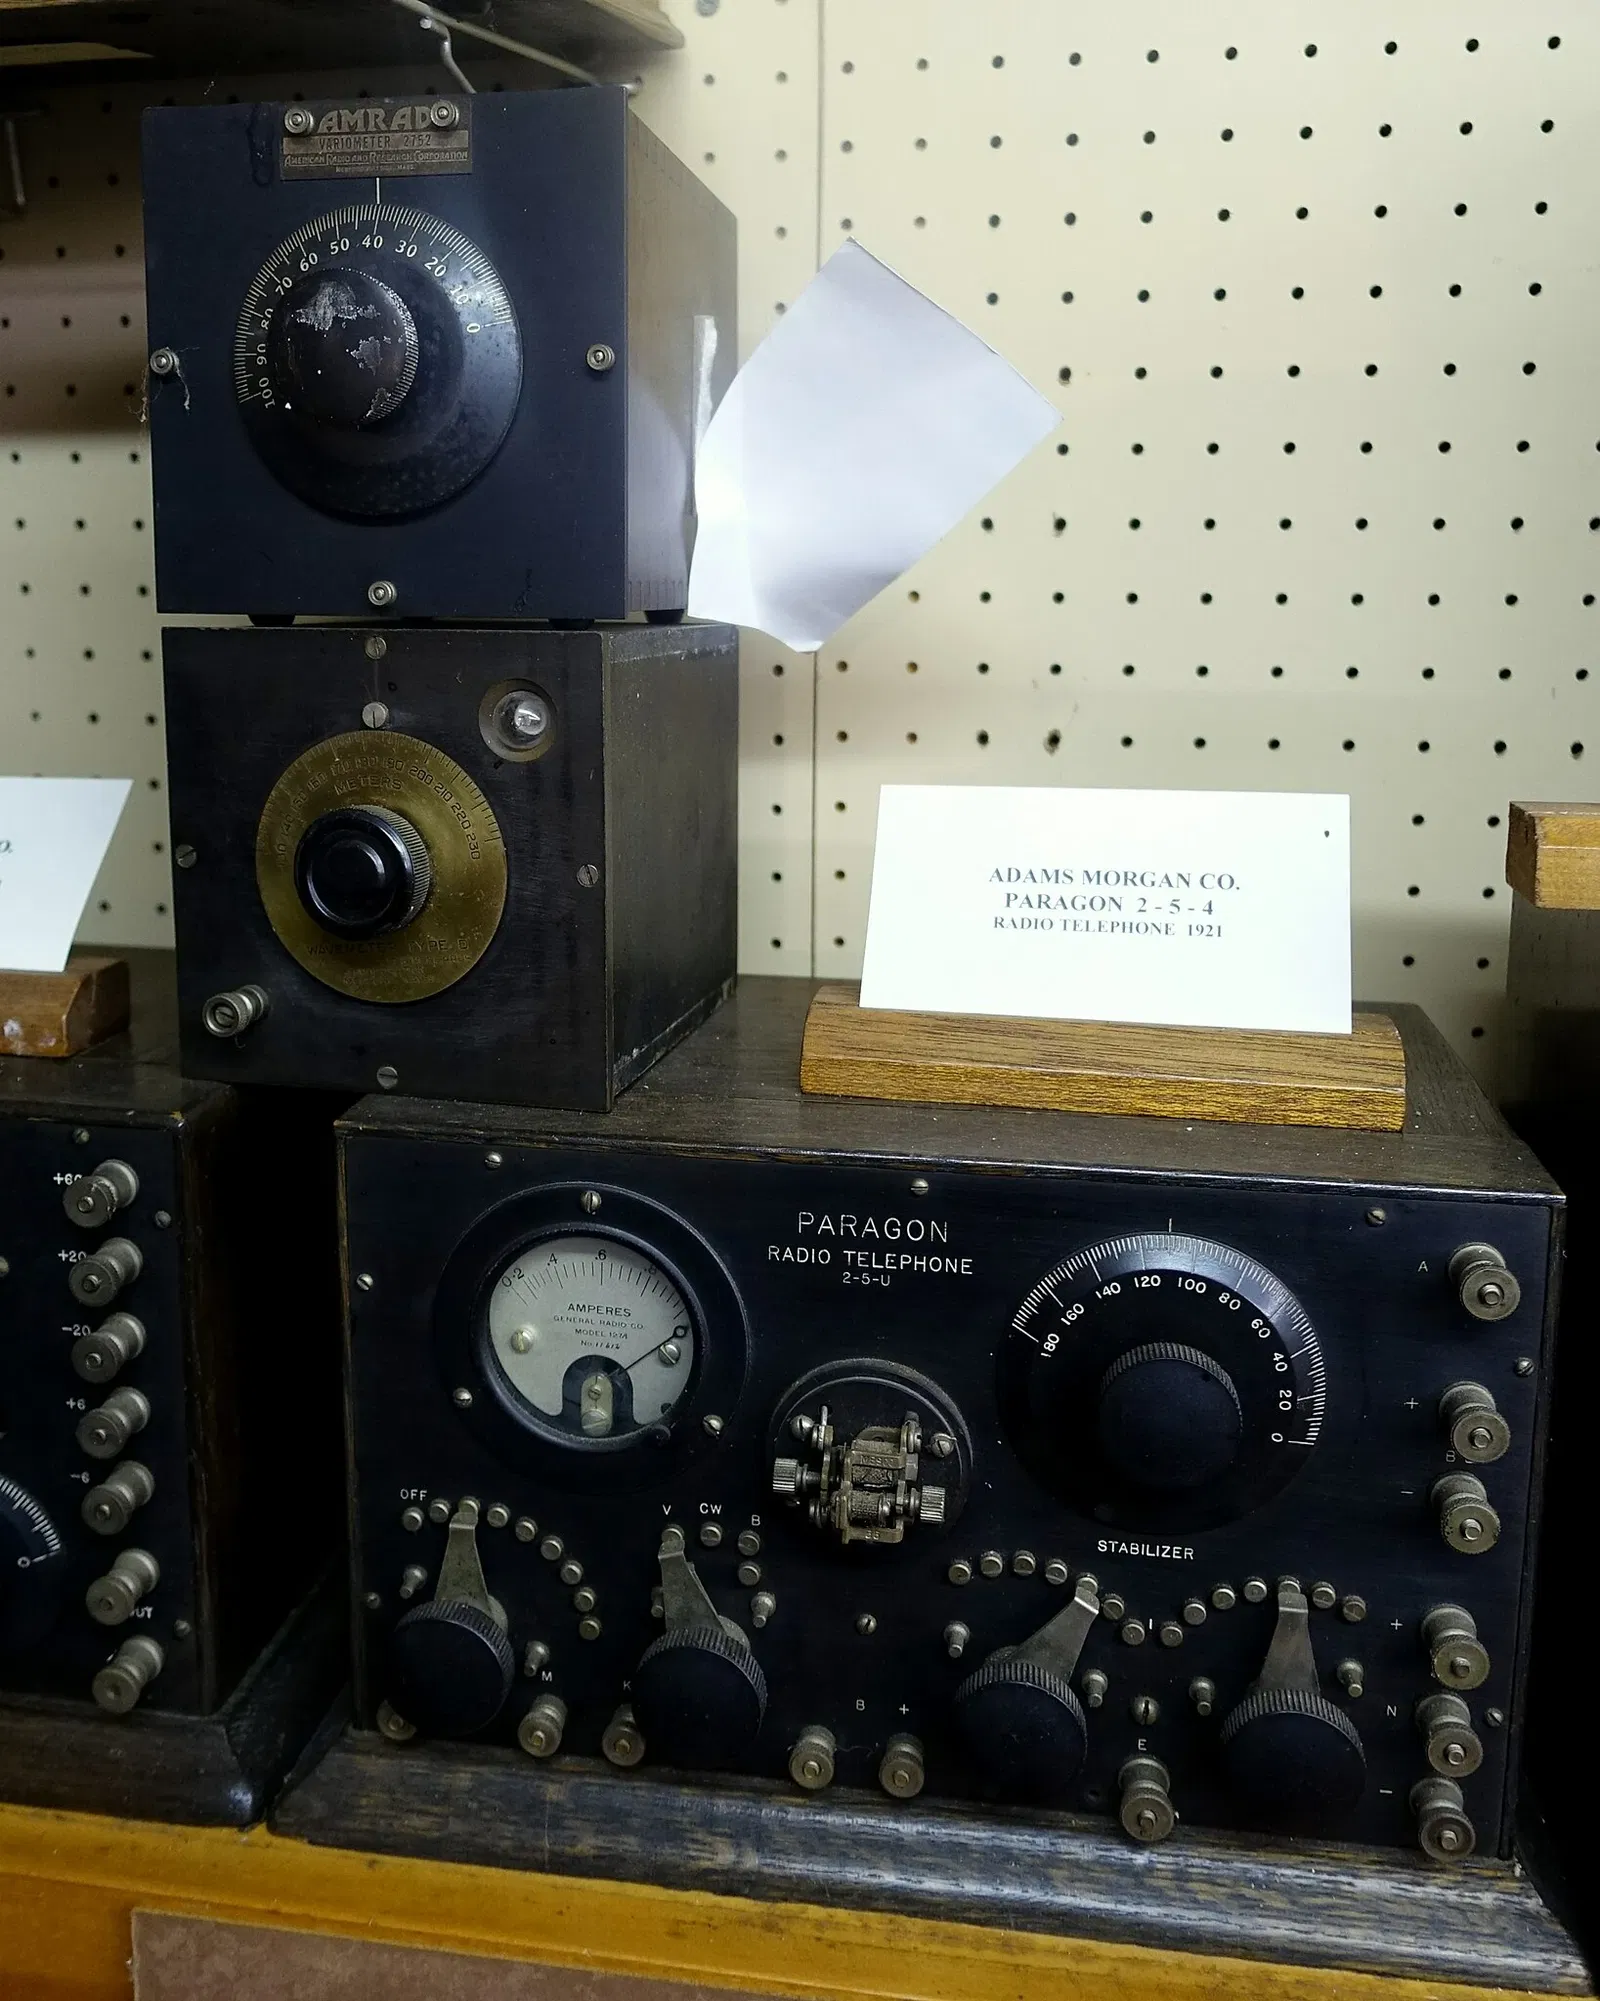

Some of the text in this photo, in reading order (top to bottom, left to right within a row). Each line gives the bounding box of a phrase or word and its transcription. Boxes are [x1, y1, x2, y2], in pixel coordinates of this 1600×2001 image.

[316, 106, 432, 133] AMRAD
[319, 135, 432, 151] VARIOMETER 2752
[326, 153, 350, 165] RADIO
[329, 237, 351, 256] 50
[361, 235, 384, 250] 40
[394, 240, 418, 258] 30
[299, 252, 319, 272] 60
[424, 256, 447, 277] 20
[274, 277, 293, 296] 70
[449, 284, 470, 306] 10
[260, 308, 274, 330] 80
[256, 343, 268, 365] 90
[258, 377, 276, 409] 100
[408, 764, 434, 786] 200
[333, 774, 403, 796] METERS
[433, 781, 454, 803] 210
[450, 802, 472, 831] 220
[465, 832, 481, 860] 230
[989, 867, 1240, 891] ADAMS MORGAN CO.
[1004, 892, 1123, 912] PARAGON
[993, 917, 1222, 938] RADIO TELEPHONE 1921
[408, 939, 448, 953] TYPE
[798, 1212, 948, 1243] PARAGON
[595, 1249, 607, 1260] .6
[768, 1245, 973, 1275] RADIO TELEPHONE
[1418, 1261, 1429, 1272] A
[842, 1271, 891, 1287] 2-5-U
[1133, 1275, 1161, 1288] 120
[1177, 1277, 1207, 1294] 100
[1095, 1282, 1121, 1299] 140
[567, 1303, 631, 1317] AMPERES
[1218, 1292, 1241, 1311] 80
[553, 1315, 595, 1325] GENERAL
[599, 1319, 628, 1328] RADIO
[1061, 1303, 1085, 1326] 160
[575, 1328, 606, 1338] MODEL
[1251, 1318, 1271, 1339] 60
[1041, 1333, 1060, 1357] 180
[1273, 1352, 1288, 1372] 40
[1279, 1389, 1292, 1411] 20
[400, 1489, 427, 1500] OFF
[662, 1505, 671, 1514] V
[699, 1504, 722, 1514] CW
[752, 1515, 761, 1526] B
[1097, 1540, 1194, 1560] STABILIZER
[541, 1671, 552, 1682] M
[623, 1681, 632, 1691] K
[855, 1699, 866, 1711] B
[1386, 1705, 1397, 1716] N
[1138, 1739, 1147, 1750] E
